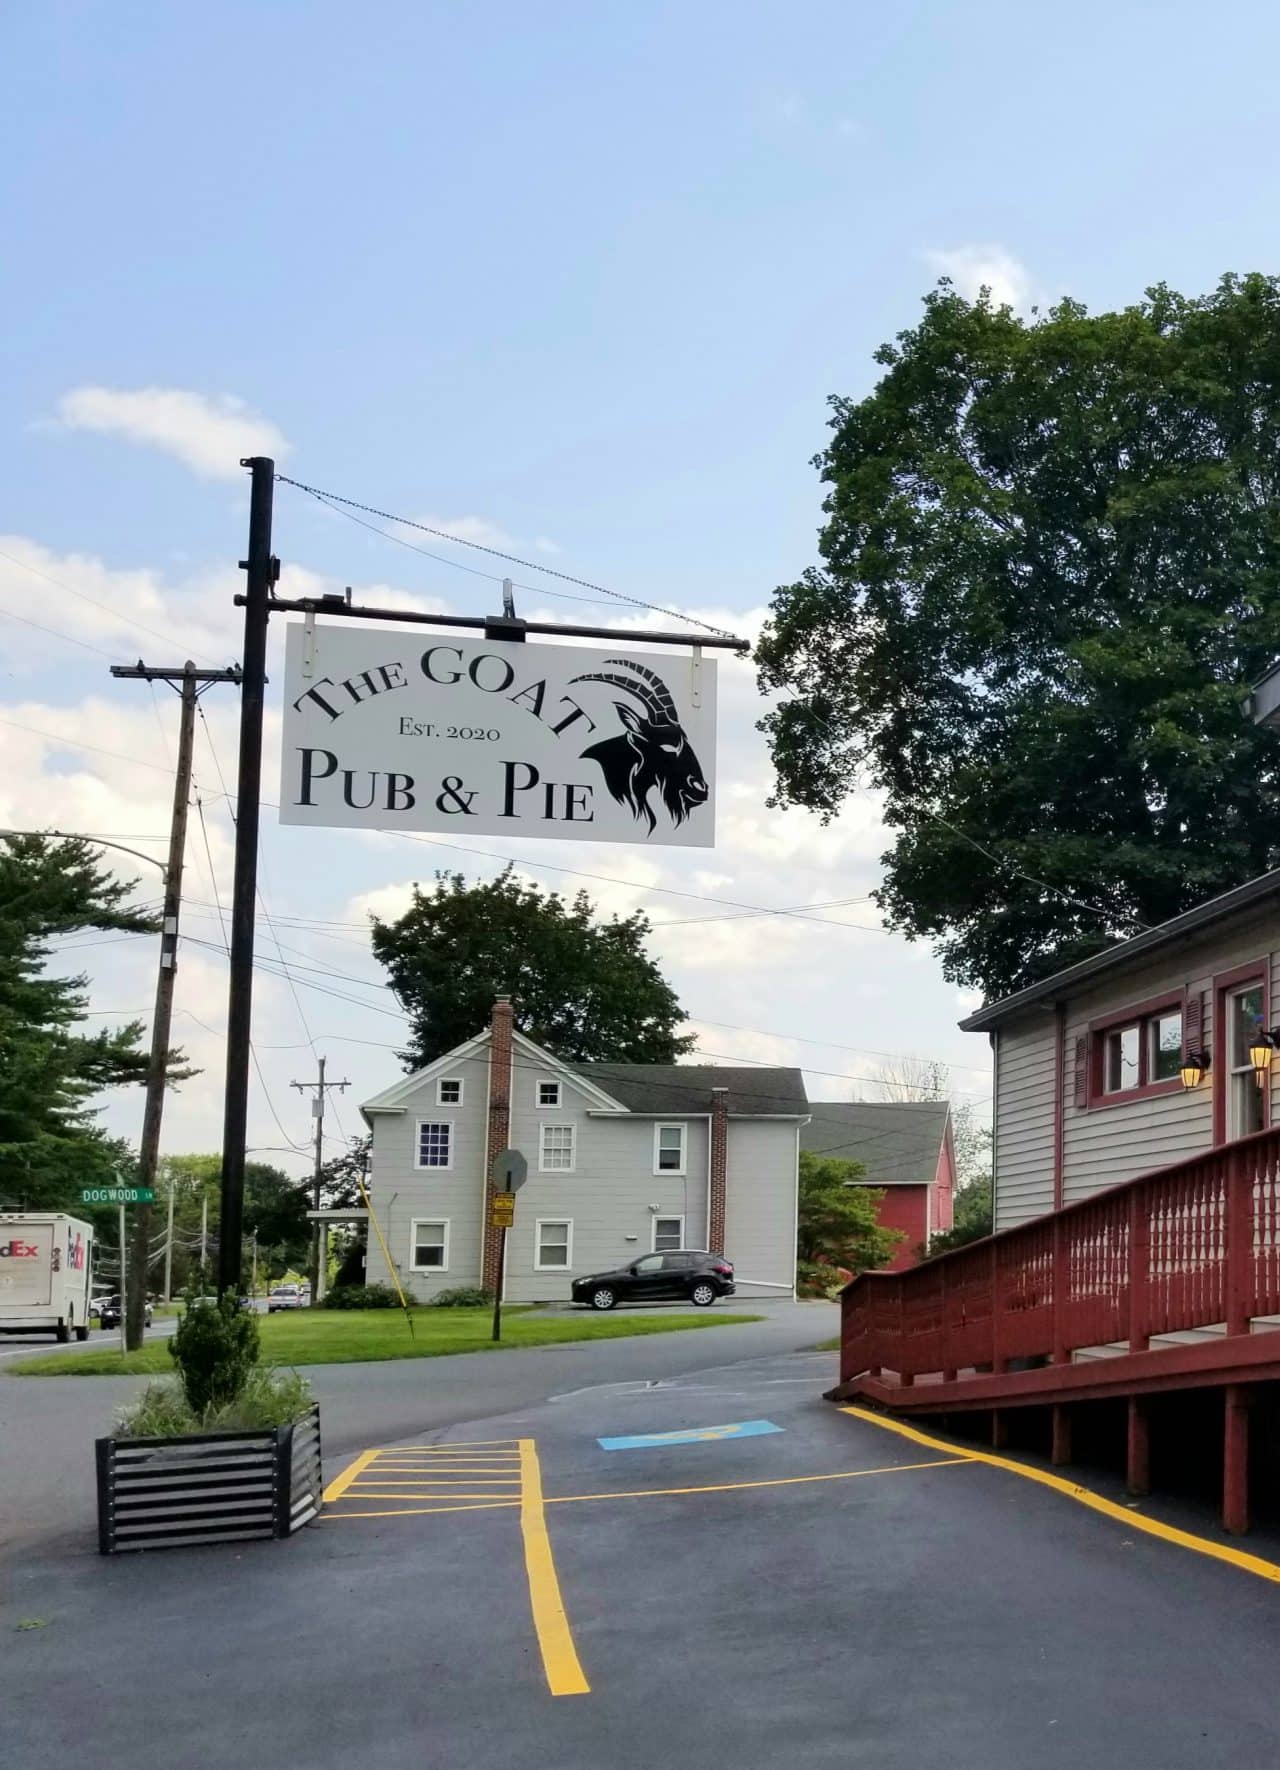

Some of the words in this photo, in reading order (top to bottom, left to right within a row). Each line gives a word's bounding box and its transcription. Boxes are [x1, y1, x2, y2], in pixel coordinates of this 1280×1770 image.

[293, 662, 408, 724] THE
[420, 646, 597, 739] GOAT
[446, 726, 501, 742] 2020
[293, 747, 416, 812] PUB
[435, 776, 479, 816] &
[497, 760, 595, 822] PIE
[83, 1189, 138, 1201] DOGWOOD
